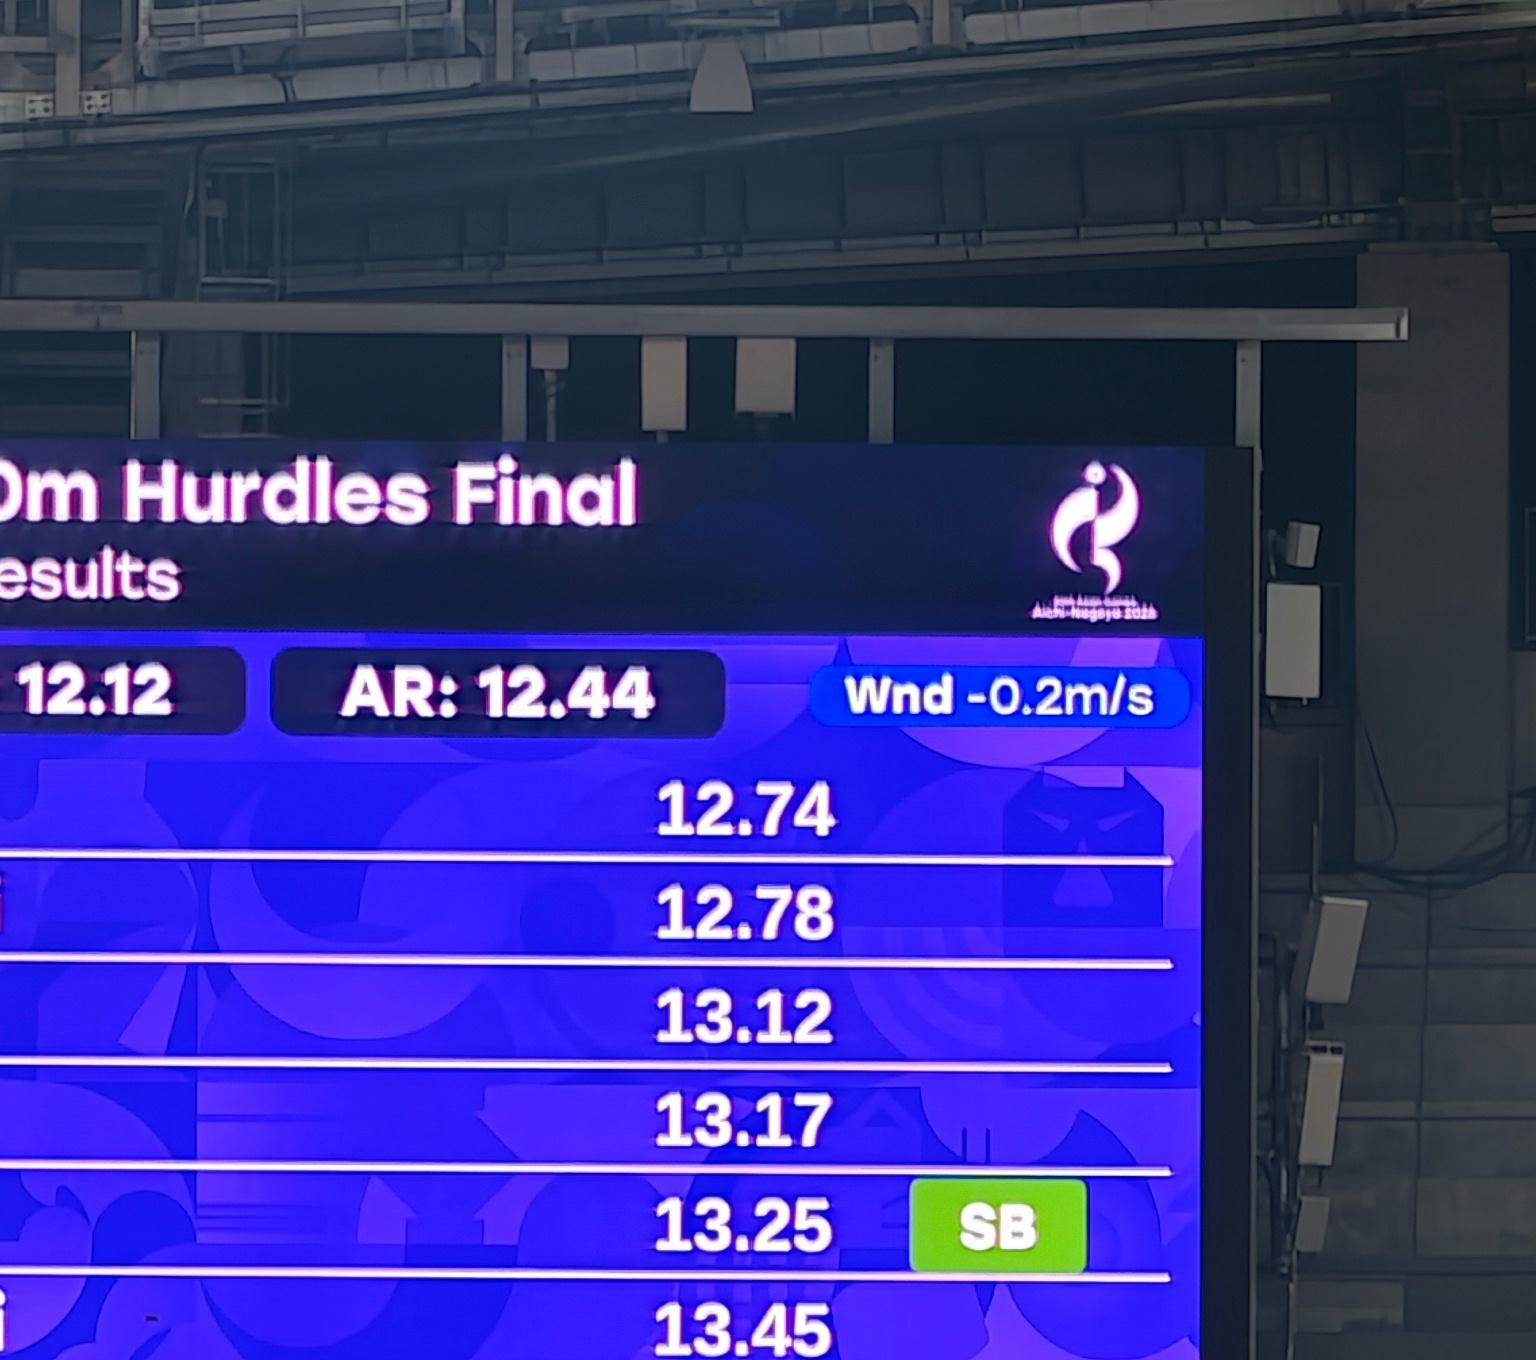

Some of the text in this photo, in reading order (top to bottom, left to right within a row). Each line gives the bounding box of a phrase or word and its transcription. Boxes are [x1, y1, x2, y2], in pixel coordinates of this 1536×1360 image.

[127, 457, 427, 524] Hurdles
[457, 455, 634, 526] Final
[19, 663, 171, 715] 12.12
[341, 666, 654, 718] AR: 12.44
[845, 673, 1152, 715] Wnd -0.2m/s
[659, 782, 835, 836] 12.74
[658, 886, 832, 940] 12.78
[658, 990, 832, 1043] 13.12
[657, 1093, 831, 1146] 13.17
[656, 1198, 831, 1252] 13.25
[961, 1203, 1036, 1250] SB
[656, 1303, 830, 1357] 13.45
